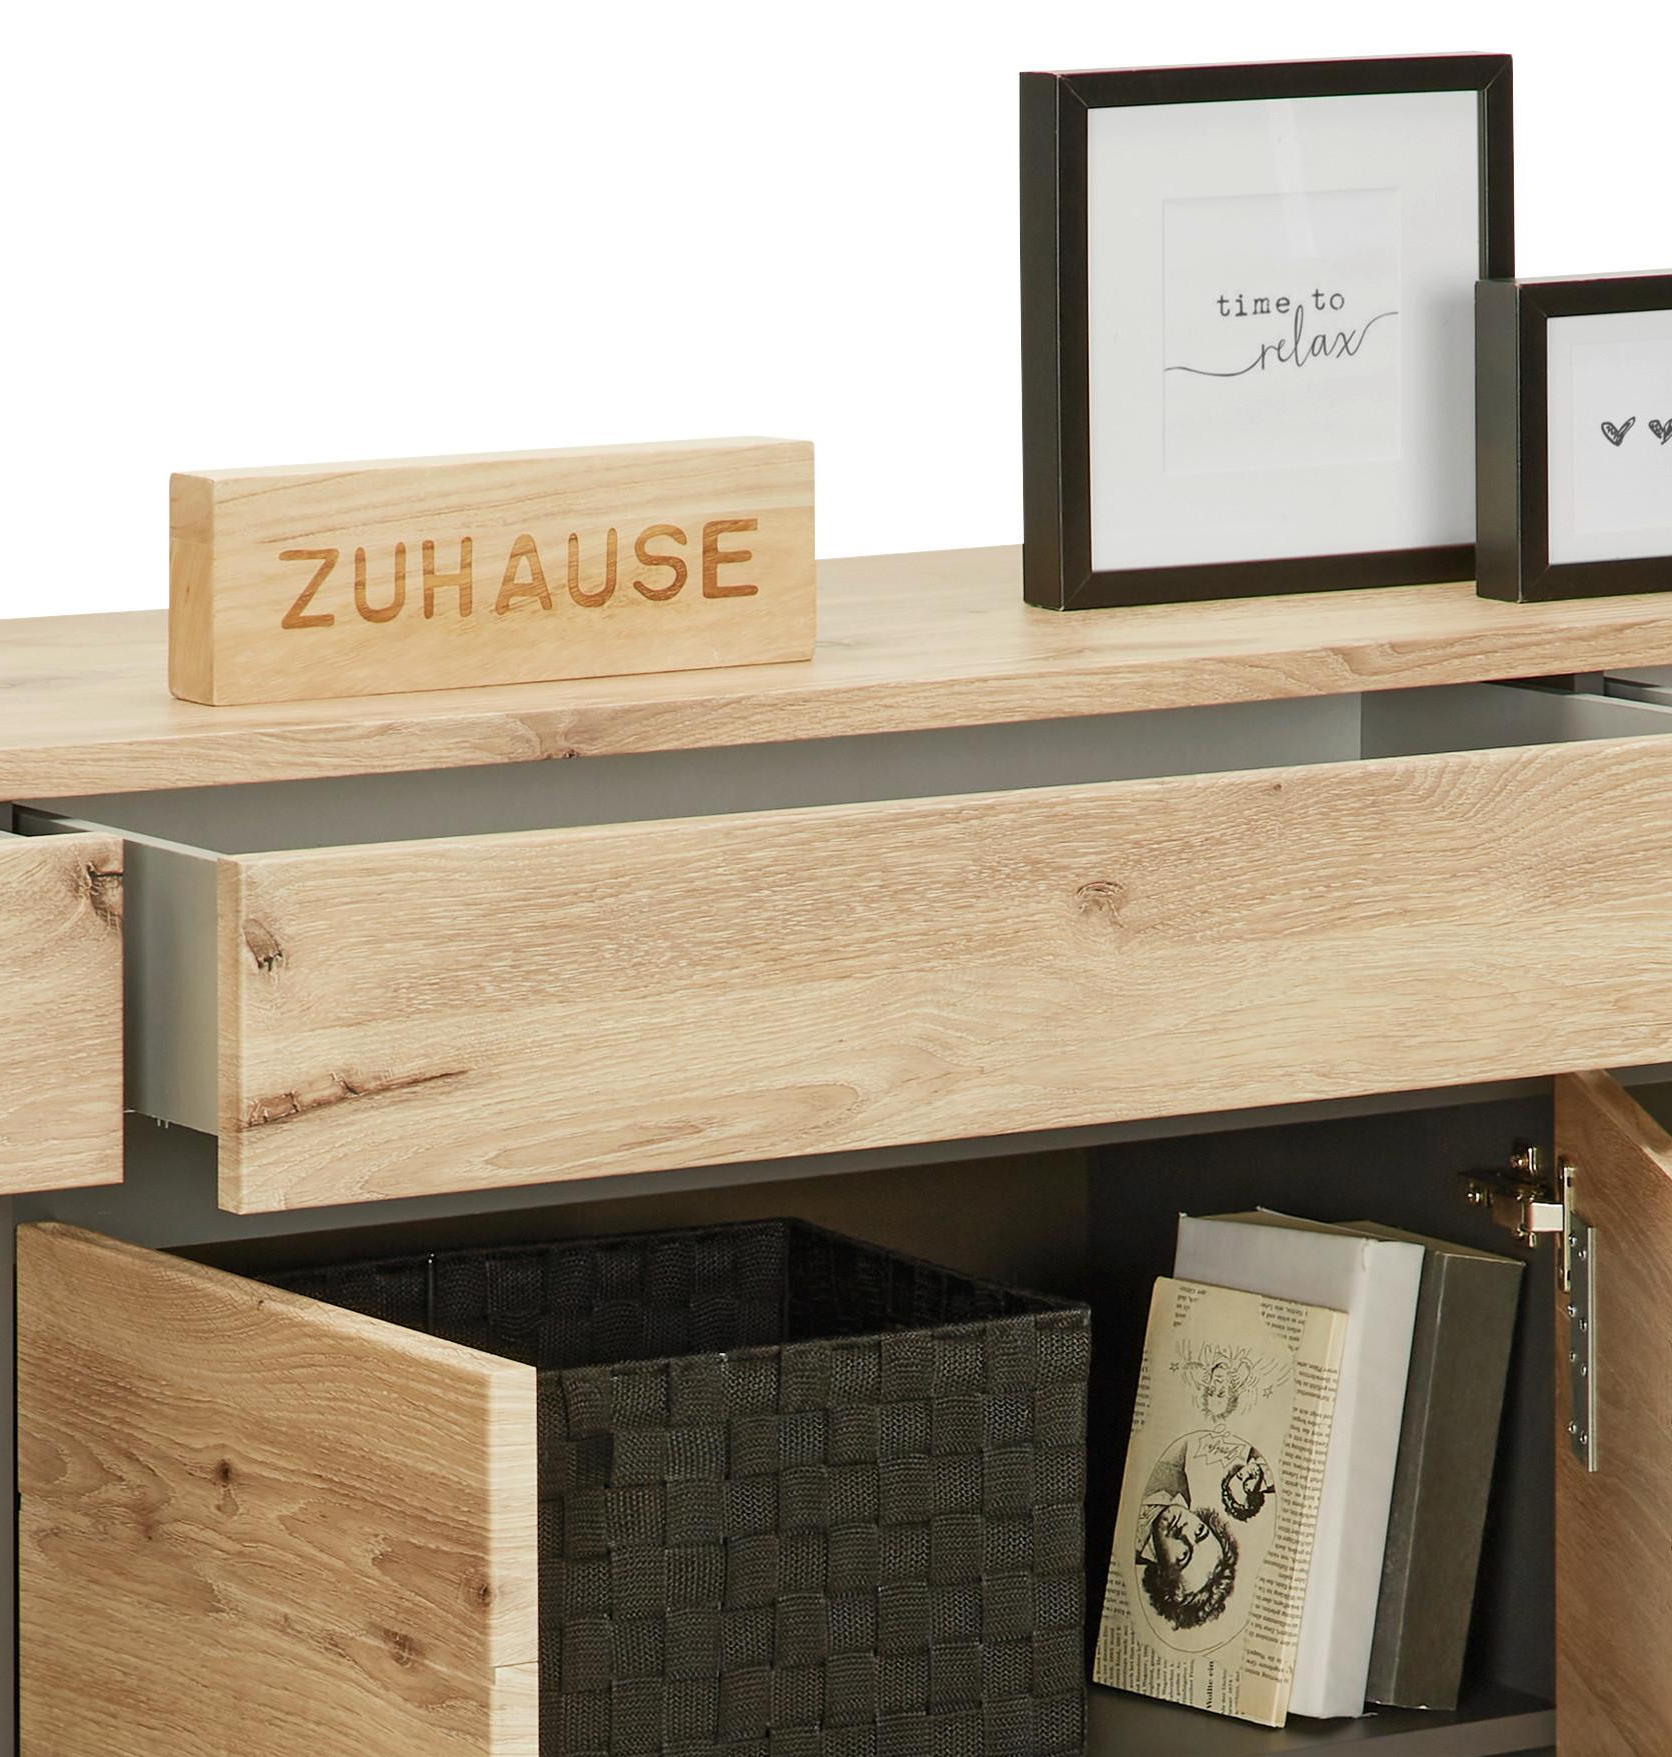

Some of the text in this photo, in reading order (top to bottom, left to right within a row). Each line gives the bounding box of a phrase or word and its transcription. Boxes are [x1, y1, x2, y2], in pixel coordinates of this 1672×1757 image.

[1216, 288, 1346, 318] time to
[1247, 303, 1373, 373] relax
[277, 517, 759, 630] ZUHAUSE
